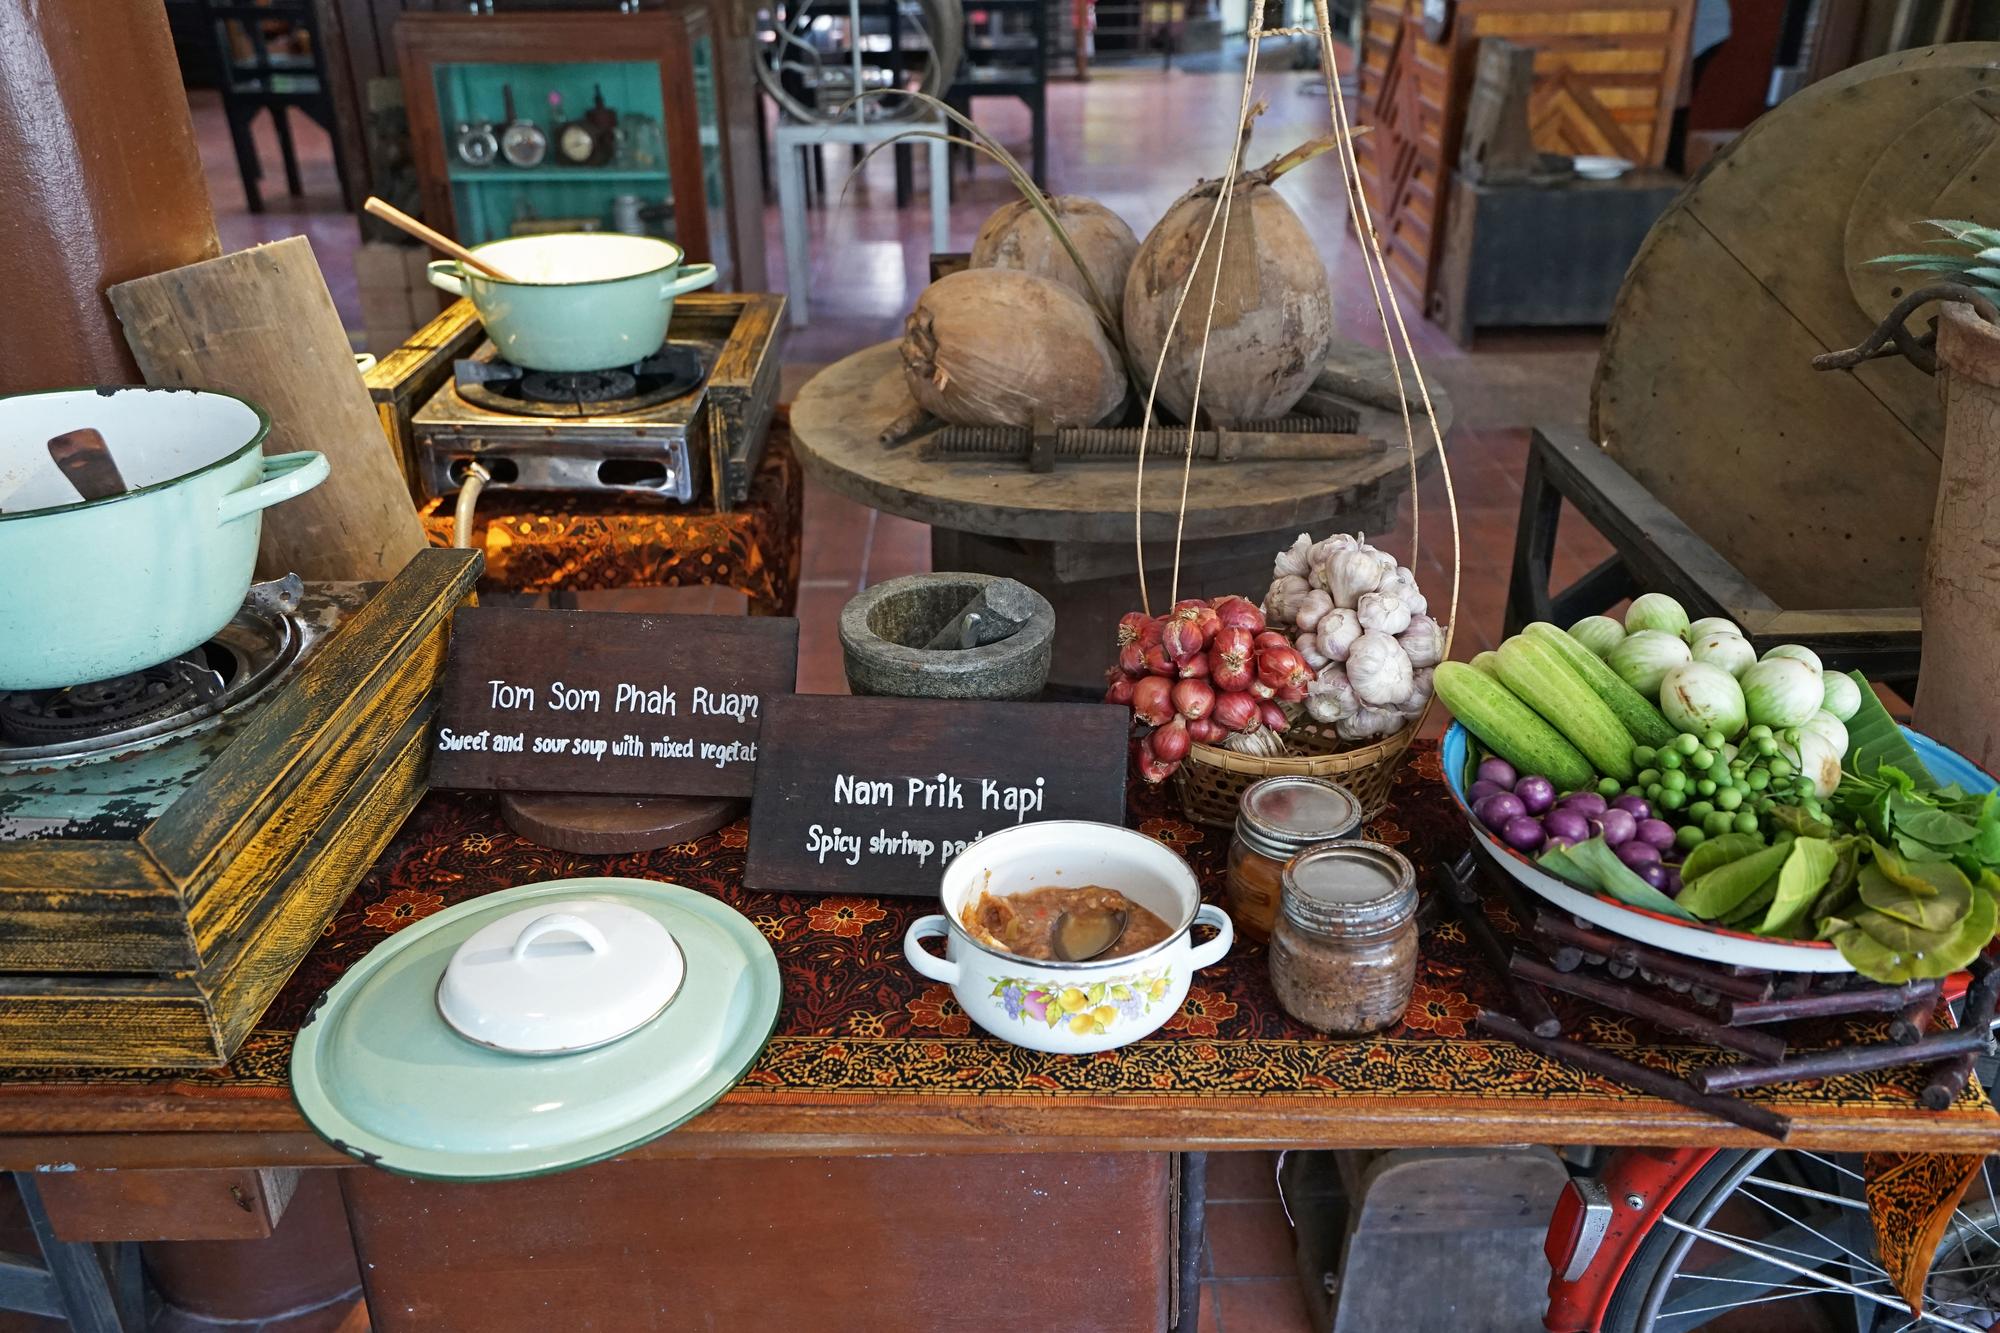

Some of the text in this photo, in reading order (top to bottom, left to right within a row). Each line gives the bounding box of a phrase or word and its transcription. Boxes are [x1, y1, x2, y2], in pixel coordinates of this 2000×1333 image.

[488, 680, 759, 718] Tom Som Phak Ruam
[438, 727, 491, 752] Sweet
[492, 732, 524, 753] and
[532, 736, 571, 754] sour
[571, 737, 608, 763] soup
[612, 734, 644, 758] with
[651, 735, 694, 759] mixed
[834, 772, 1045, 824] Nam Prik Kapi
[806, 824, 862, 866] Spicy
[868, 828, 935, 868] shrimp
